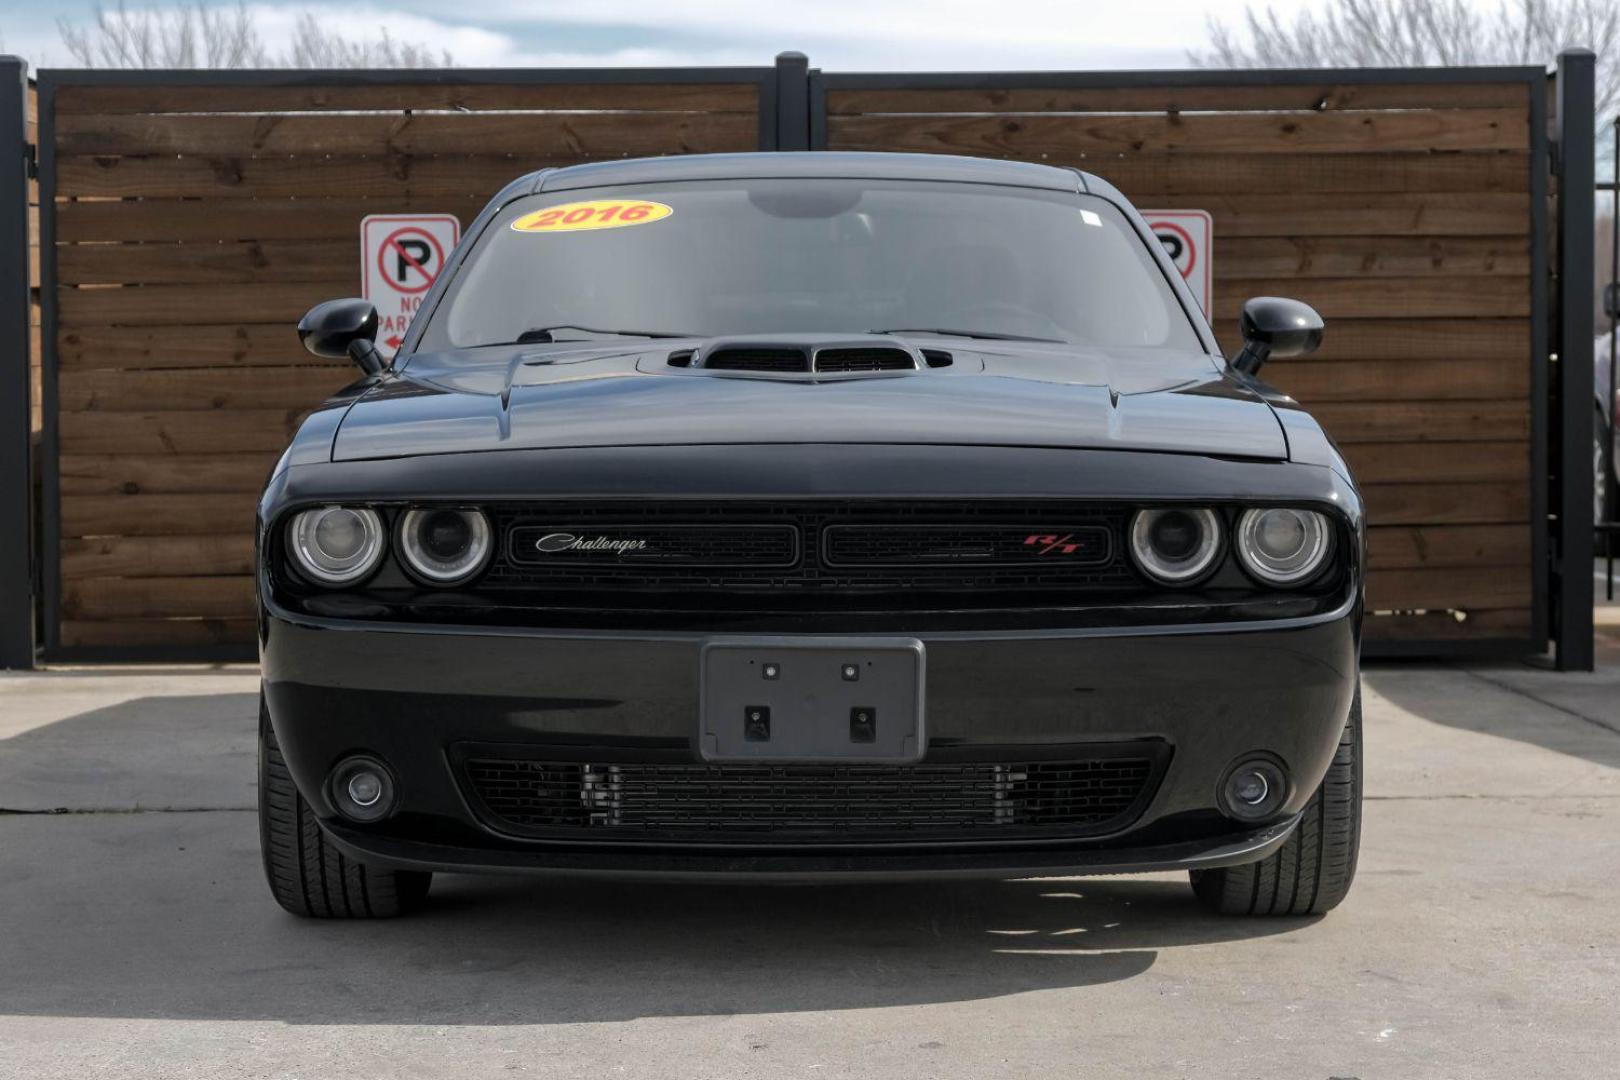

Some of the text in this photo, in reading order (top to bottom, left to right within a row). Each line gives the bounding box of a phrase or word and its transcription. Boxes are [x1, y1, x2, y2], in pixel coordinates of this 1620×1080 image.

[526, 204, 654, 228] 2016
[397, 240, 431, 282] P
[400, 297, 421, 313] NO
[535, 532, 647, 555] Challenger
[1023, 533, 1085, 555] R/T
